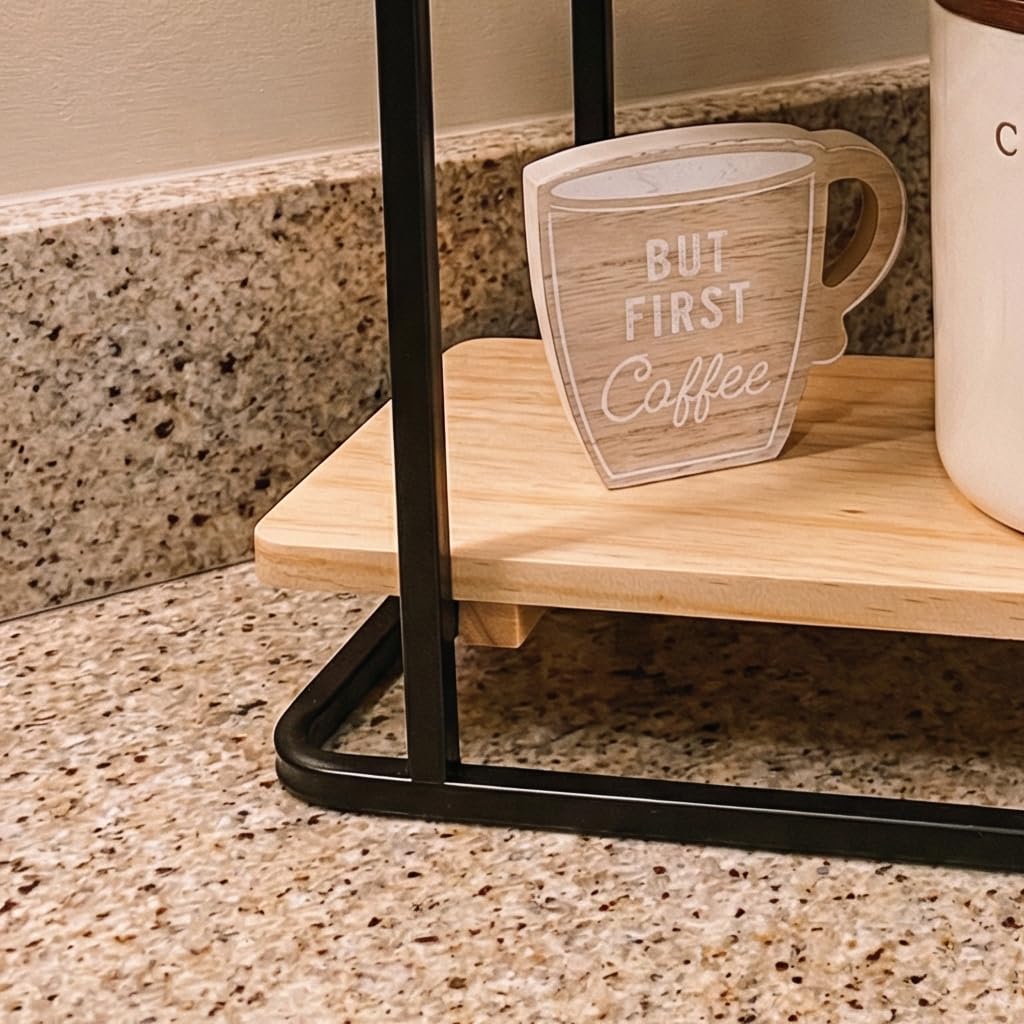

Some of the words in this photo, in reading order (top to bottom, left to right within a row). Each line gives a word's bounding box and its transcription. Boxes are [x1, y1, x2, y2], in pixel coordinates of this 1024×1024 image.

[646, 230, 728, 281] BUT
[624, 281, 750, 342] FIRST
[601, 353, 770, 427] Coffee
